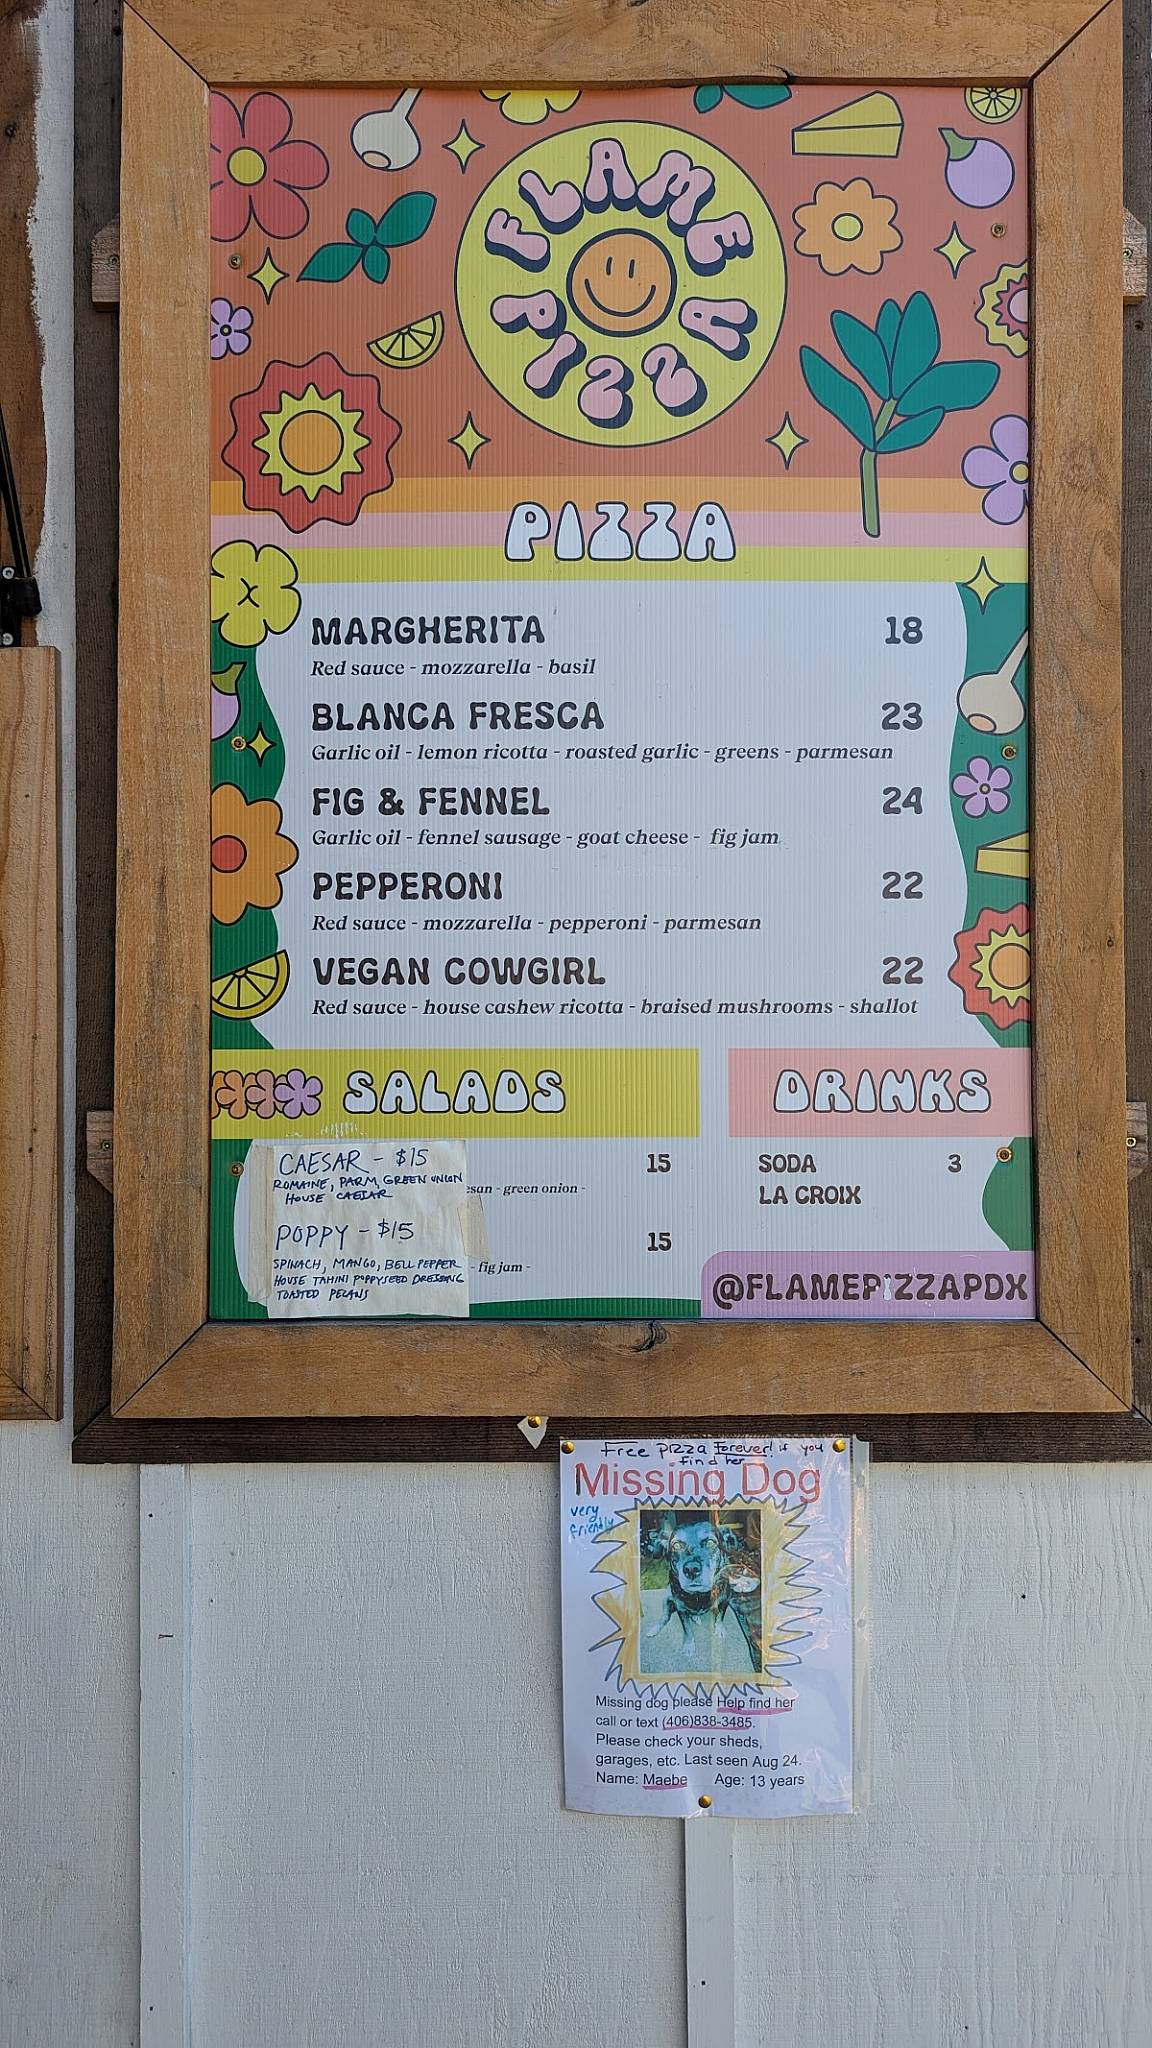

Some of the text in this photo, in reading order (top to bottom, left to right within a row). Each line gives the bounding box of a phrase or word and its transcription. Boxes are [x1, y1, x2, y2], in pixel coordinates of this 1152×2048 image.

[484, 137, 754, 277] FLAME
[490, 289, 758, 430] PIZZA
[505, 501, 737, 563] PIZZA
[311, 615, 546, 645] MARGHERITA
[885, 616, 923, 644] 18
[310, 660, 346, 676] Red
[351, 663, 404, 676] sauce
[421, 659, 531, 675] mozzarella
[548, 658, 596, 674] basil
[312, 701, 605, 731] BLANCA FRESCA
[881, 702, 923, 730] 23
[311, 744, 371, 760] Garlic
[377, 744, 401, 760] oil
[417, 744, 477, 760] lemon
[483, 744, 548, 760] ricotta
[565, 744, 638, 760] roasted
[642, 743, 699, 763] garlic
[714, 746, 779, 763] greens
[796, 746, 893, 763] parmesan
[312, 787, 550, 816] FIG & FENNEL
[882, 786, 923, 815] 24
[312, 829, 371, 845] Garlic
[376, 829, 401, 845] oil
[417, 829, 479, 845] fennel
[484, 832, 561, 849] sausage
[576, 830, 620, 849] goat
[625, 829, 688, 844] cheese
[709, 828, 737, 848] fig
[739, 829, 779, 848] jam
[312, 872, 503, 900] PEPPERONI
[882, 871, 923, 899] 22
[312, 915, 348, 930] Red
[352, 918, 406, 930] sauce
[423, 915, 532, 930] mozzarella
[548, 914, 648, 934] pepperoni
[663, 917, 761, 933] parmesan
[312, 957, 606, 985] VEGAN COWGIRL
[882, 956, 923, 985] 22
[312, 1000, 348, 1015] Red
[353, 1002, 406, 1015] sauce
[423, 999, 480, 1015] house
[485, 998, 555, 1015] cashew
[559, 998, 624, 1014] ricotta
[640, 998, 711, 1014] braised
[717, 998, 833, 1014] mushrooms
[850, 998, 918, 1014] shallot
[343, 1069, 566, 1114] SALADS
[773, 1068, 991, 1113] DRINKS
[279, 1149, 369, 1175] CAESAR
[395, 1147, 429, 1167] $15
[646, 1153, 672, 1173] 15
[758, 1153, 817, 1173] SODA
[947, 1153, 962, 1173] 3
[273, 1177, 334, 1192] ROMAINE,
[383, 1174, 427, 1185] GREEN
[503, 1185, 539, 1196] green
[541, 1182, 578, 1194] onion
[286, 1193, 324, 1205] HOUSE
[759, 1185, 862, 1205] LA CROIX
[276, 1224, 349, 1250] POPPY
[377, 1218, 414, 1240] $15
[647, 1232, 672, 1252] 15
[273, 1257, 462, 1275] SPINACH, MANGO, BELL PEPPER
[478, 1261, 495, 1274] fig
[498, 1262, 523, 1274] jam
[274, 1275, 307, 1286] HOUSE
[313, 1274, 349, 1285] TAHINI
[353, 1275, 408, 1286] POPPYSEED
[277, 1288, 369, 1301] TOASTED PECANS
[712, 1271, 1029, 1311] @FLAMEPIZZAPDX
[601, 1441, 650, 1457] Free
[680, 1454, 745, 1466] find her
[576, 1462, 821, 1505] Missing Dog
[595, 1696, 796, 1711] Missing dog please Help find her
[596, 1715, 756, 1729] call or text (406)838-3485.
[596, 1733, 763, 1750] Please check your sheds,
[595, 1753, 802, 1771] garages, etc. Last seen Aug 24.
[596, 1771, 688, 1786] Name: Maebe
[714, 1773, 805, 1790] Age: 13 years
